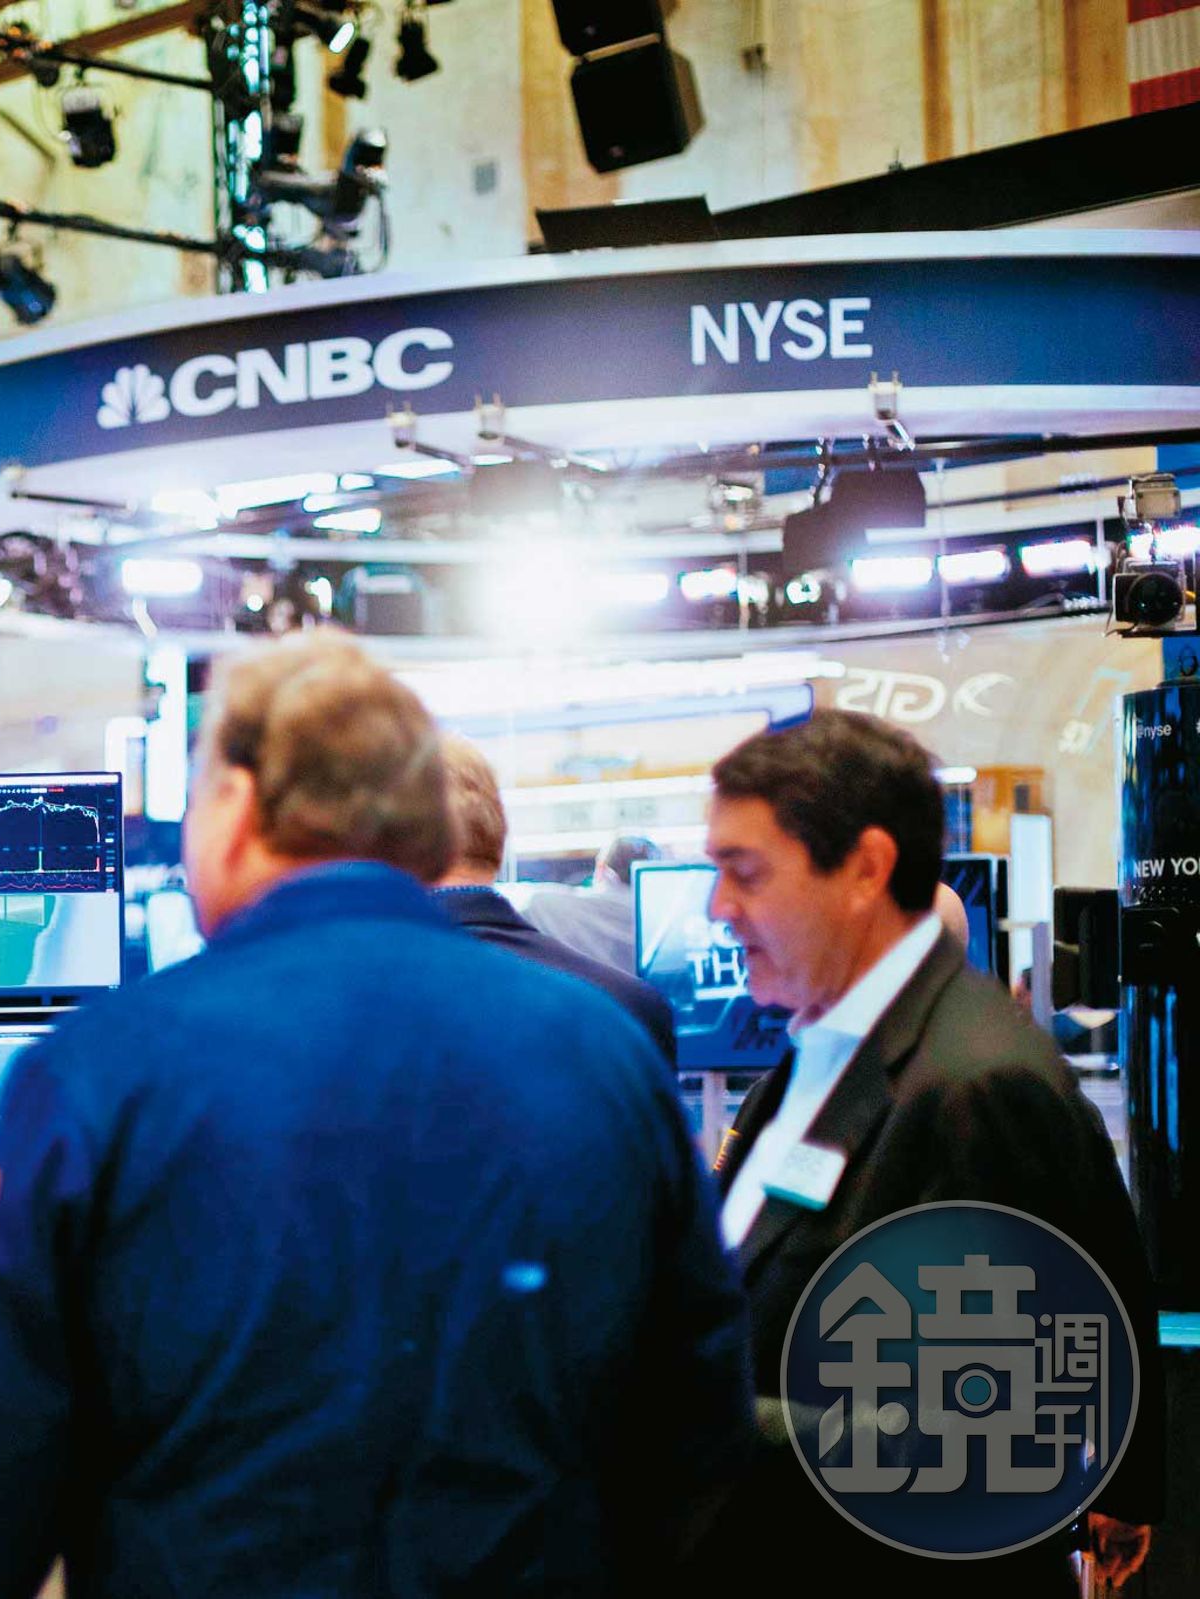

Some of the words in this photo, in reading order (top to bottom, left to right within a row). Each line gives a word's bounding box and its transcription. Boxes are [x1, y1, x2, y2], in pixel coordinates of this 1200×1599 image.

[690, 297, 873, 365] NYSE
[169, 327, 454, 418] CNBC
[1133, 859, 1165, 877] NEW
[1170, 857, 1200, 876] YO
